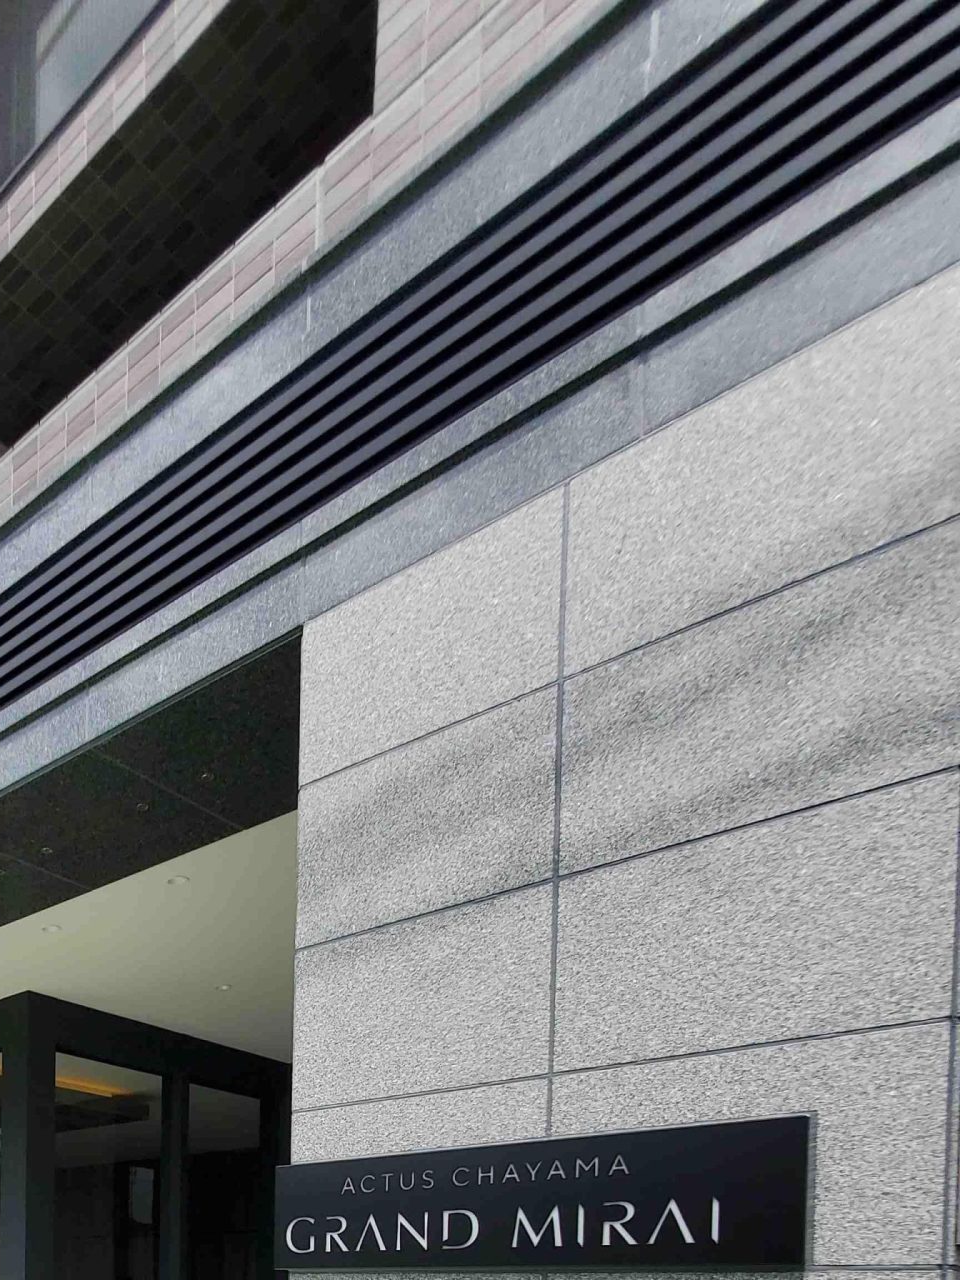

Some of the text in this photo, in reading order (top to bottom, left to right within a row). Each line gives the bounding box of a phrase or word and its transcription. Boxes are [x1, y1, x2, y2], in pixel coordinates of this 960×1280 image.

[340, 1154, 630, 1195] ACTUS CHAYAMA
[284, 1197, 721, 1254] GRAND MIRAI
